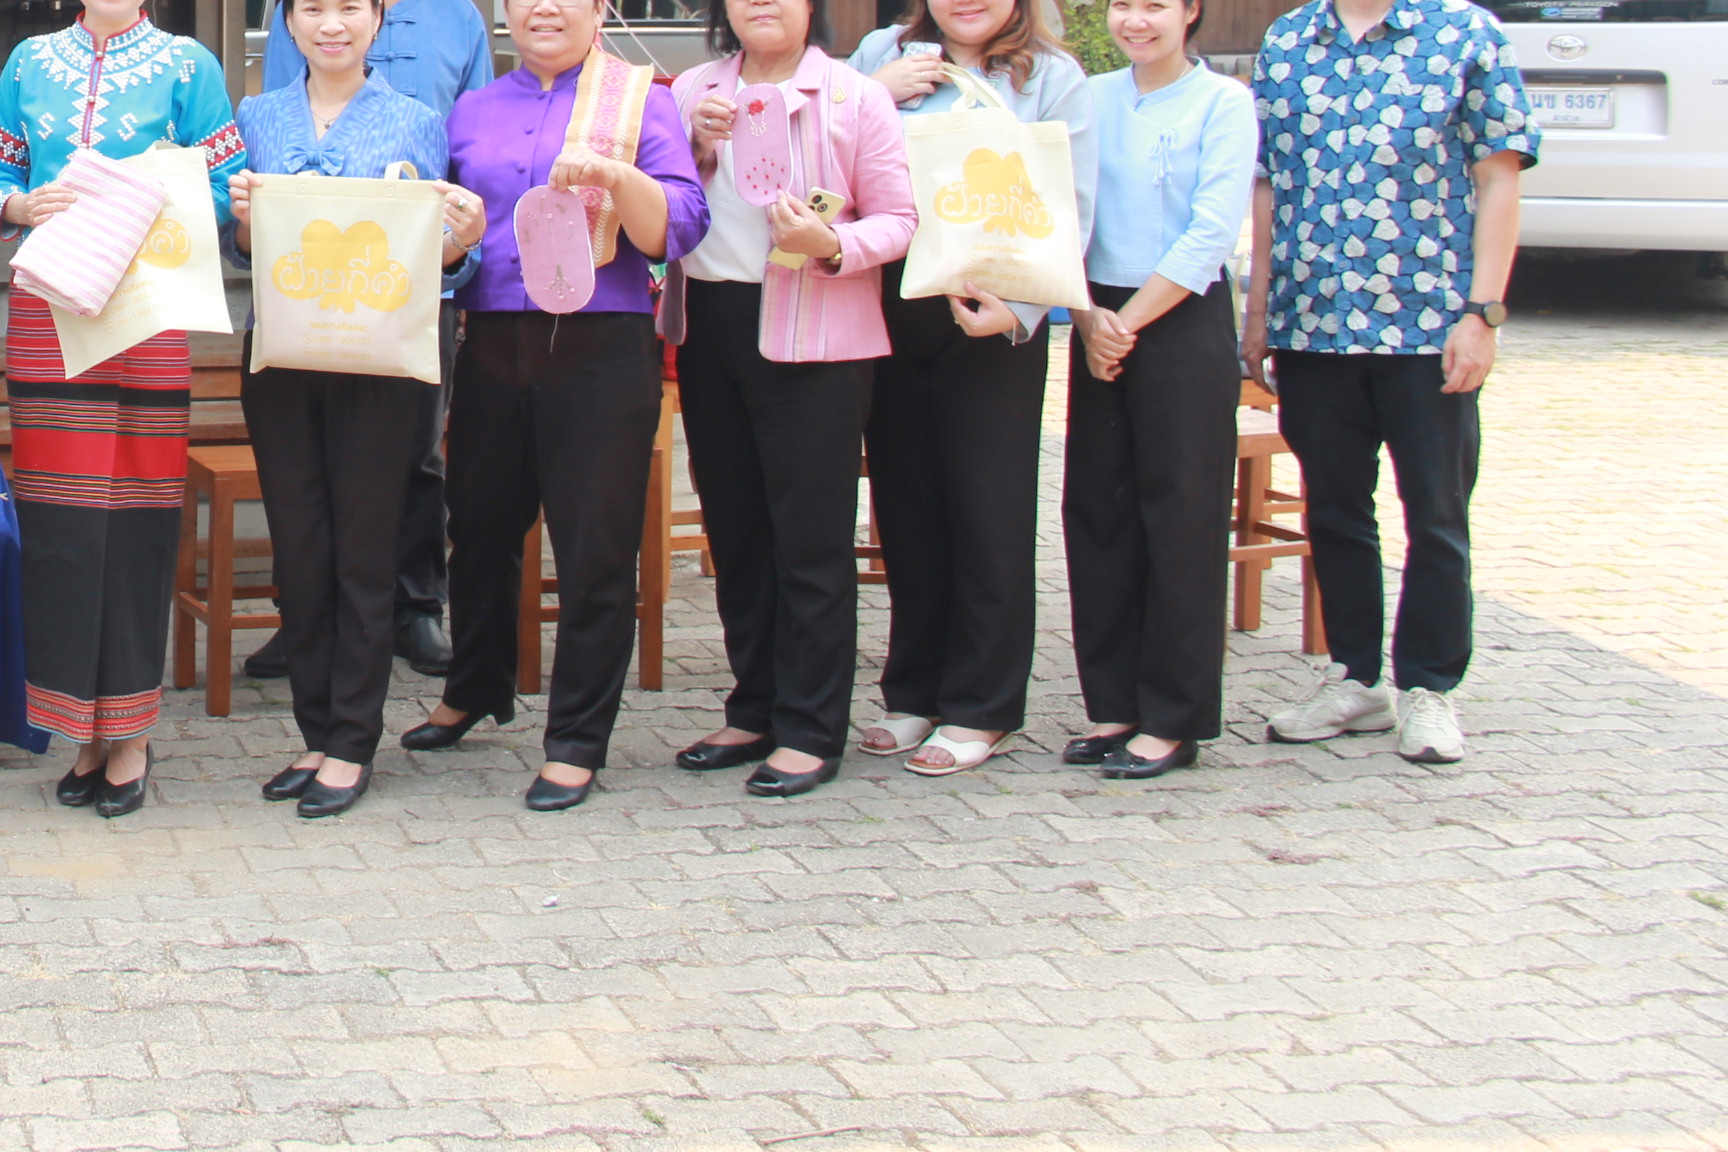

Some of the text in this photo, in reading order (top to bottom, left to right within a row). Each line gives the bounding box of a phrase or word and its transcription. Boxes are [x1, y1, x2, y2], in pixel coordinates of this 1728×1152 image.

[1565, 94, 1606, 109] 6367
[940, 175, 1052, 227] ฝ้ายกี่คำ
[279, 245, 410, 296] ฝ้ายกี่คำ
